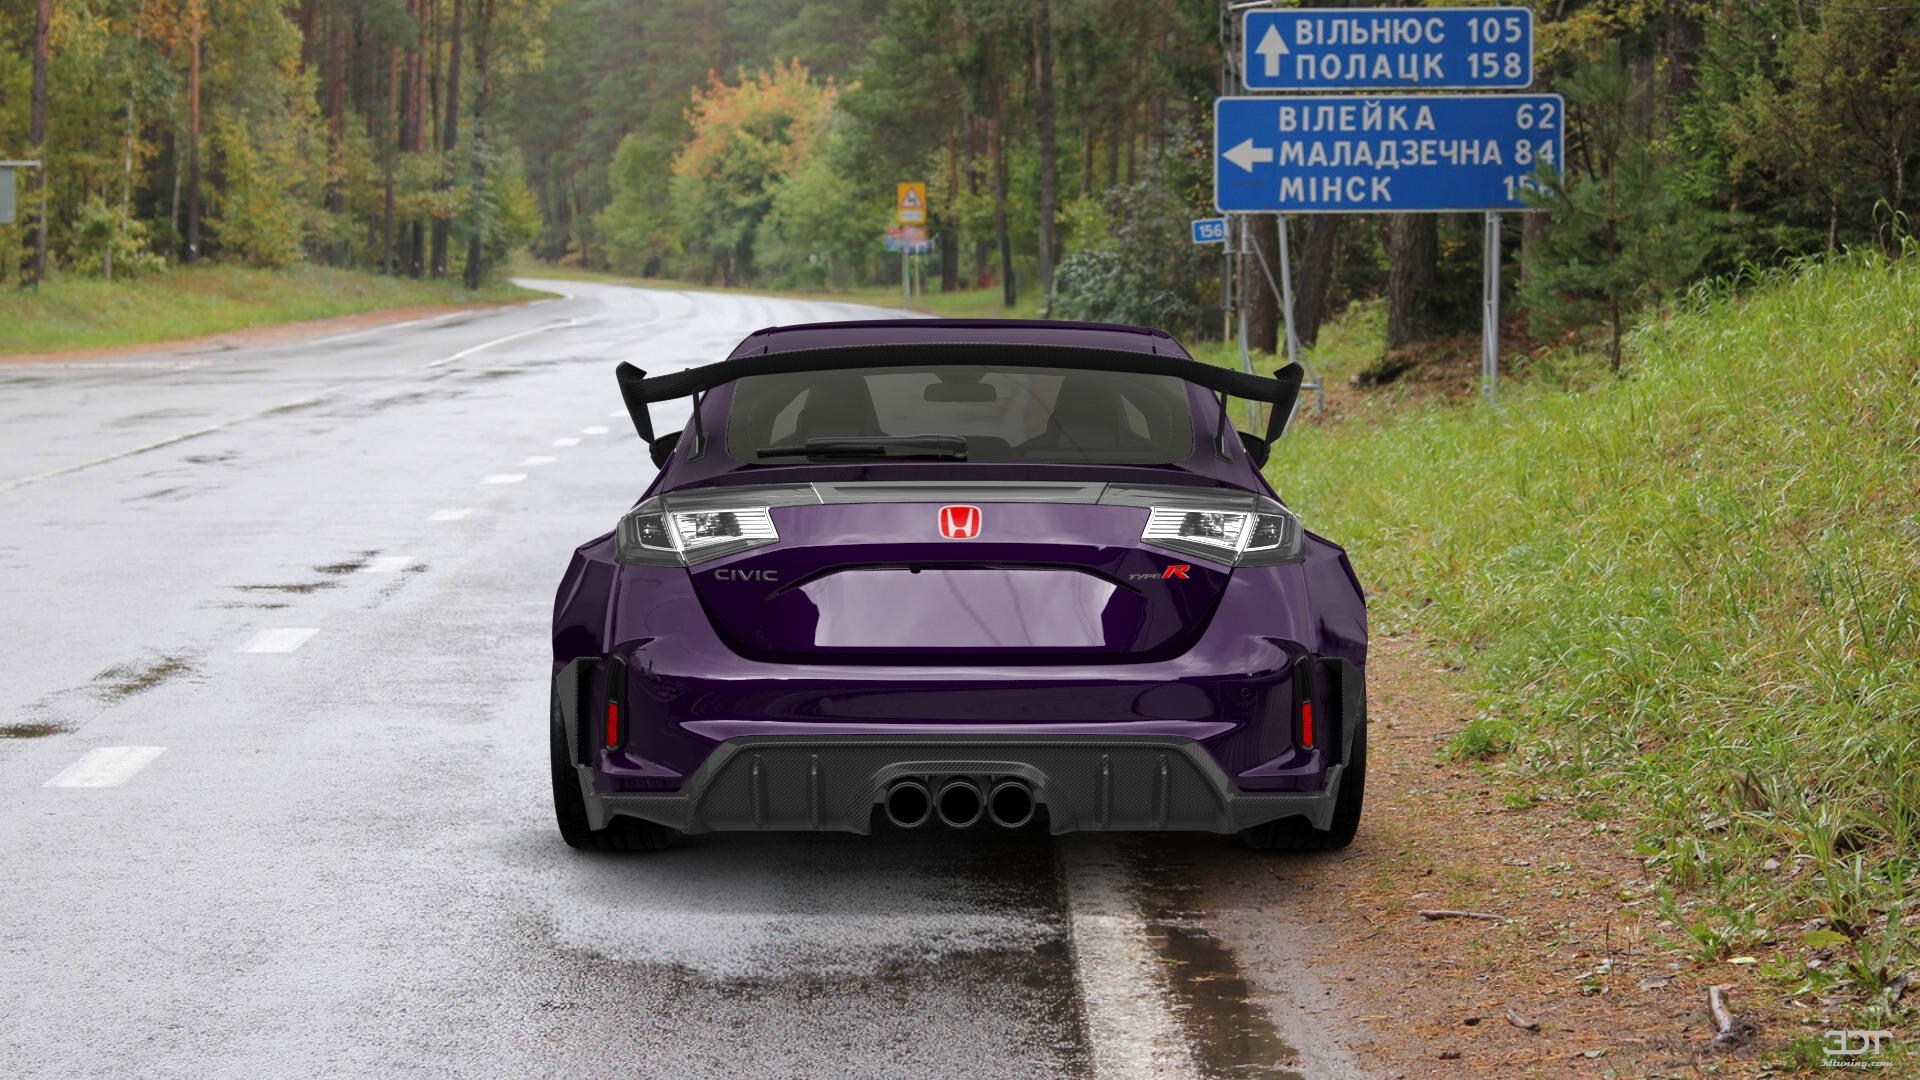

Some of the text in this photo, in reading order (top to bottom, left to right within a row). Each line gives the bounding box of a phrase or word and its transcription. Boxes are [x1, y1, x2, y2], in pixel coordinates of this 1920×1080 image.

[1296, 17, 1522, 45] ВІЛЬНЮС 105
[1296, 53, 1523, 82] ПОЛАЦК 158
[1279, 100, 1555, 132] ВІЛЕЙКА 62
[1279, 139, 1555, 170] МАЛАДЗЕЧНА 84
[1279, 176, 1392, 202] МІНСК
[1200, 223, 1222, 238] 156
[714, 568, 779, 582] CIVIC
[1161, 564, 1191, 579] R
